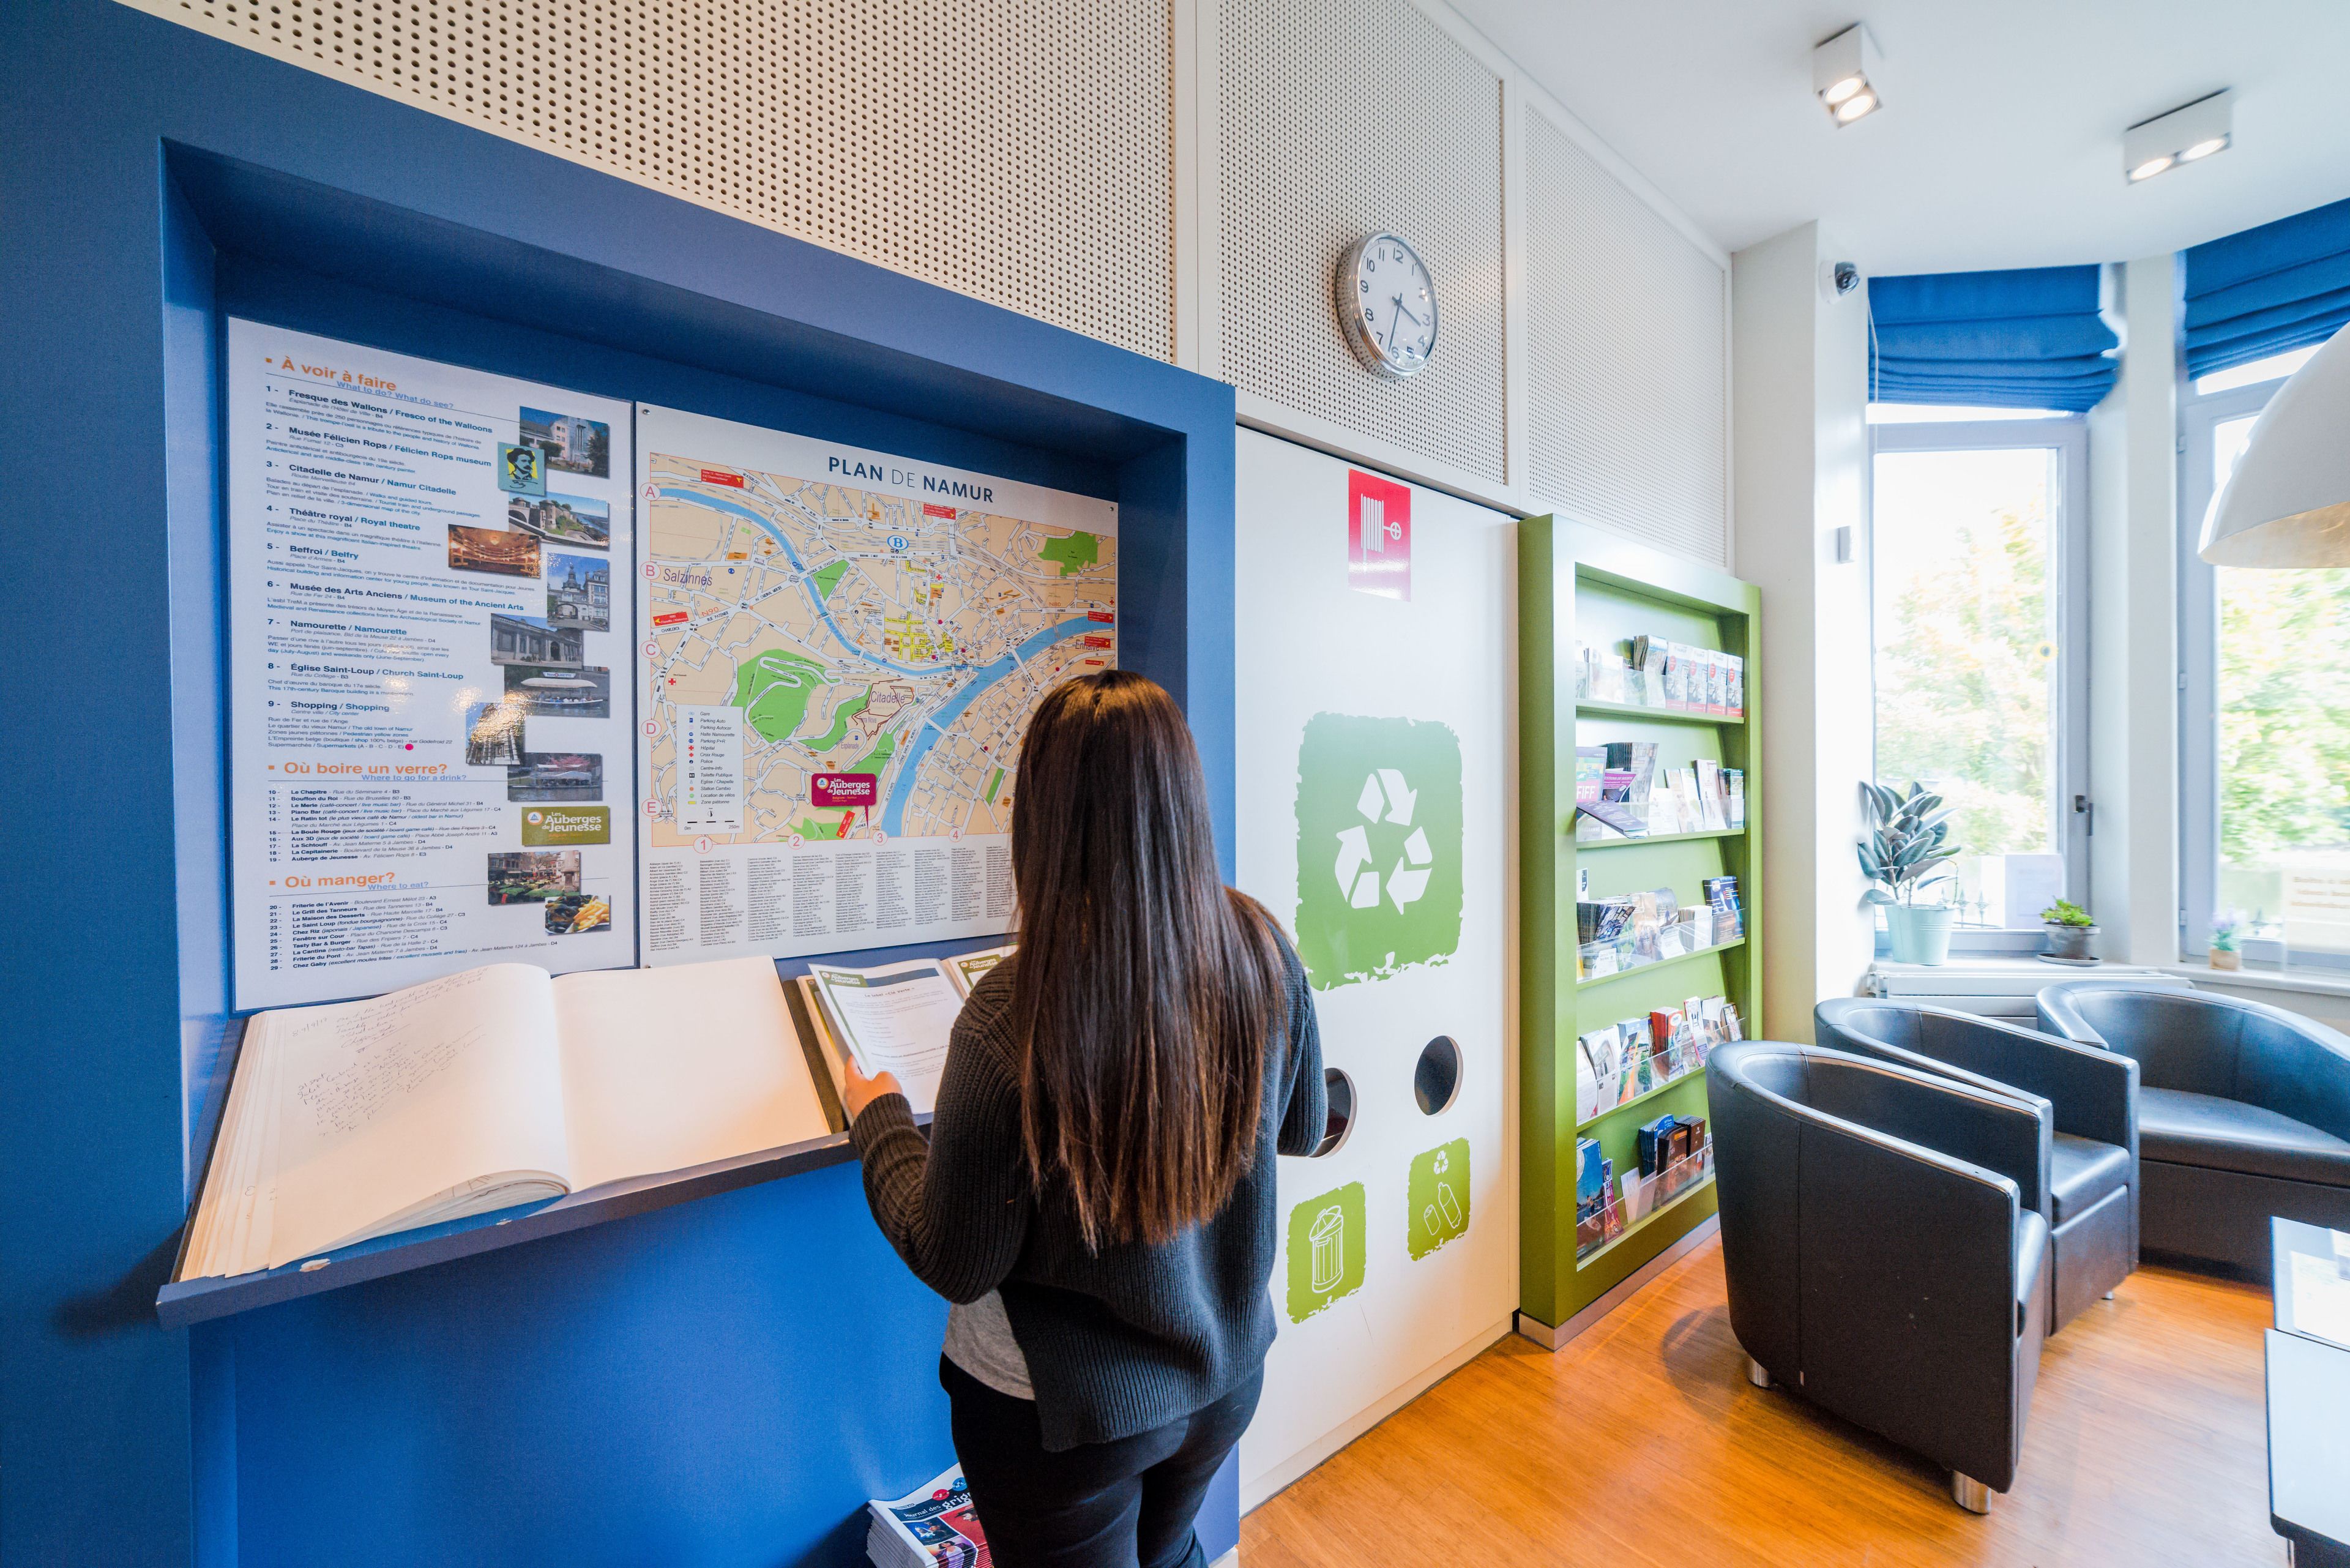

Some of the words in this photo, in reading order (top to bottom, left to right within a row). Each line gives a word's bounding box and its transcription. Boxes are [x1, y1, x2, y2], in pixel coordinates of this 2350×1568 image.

[1379, 247, 1384, 261] 11
[1393, 247, 1403, 264] 12
[1367, 258, 1375, 272] 10
[1360, 280, 1368, 293] 9
[1365, 308, 1373, 321] 8
[1423, 313, 1430, 326] 3
[1376, 331, 1384, 345] 7
[1418, 335, 1425, 347] 4
[1391, 346, 1400, 359] 6
[1407, 346, 1414, 359] 5
[281, 354, 294, 371] À
[300, 362, 337, 379] voir
[341, 369, 352, 383] à
[357, 373, 397, 392] faire
[337, 381, 360, 391] What
[375, 388, 392, 398] do?
[395, 392, 417, 403] What
[420, 397, 431, 405] do
[433, 401, 454, 409] see?
[288, 389, 329, 405] Fresque
[330, 397, 348, 406] des
[350, 400, 388, 414] Wallons
[395, 409, 426, 421] Fresco
[438, 417, 452, 426] the
[454, 420, 493, 433] Walloons
[289, 426, 322, 438] Musée
[323, 432, 360, 444] Félicien
[362, 439, 387, 450] Rops
[394, 444, 429, 456] Félicien
[430, 450, 453, 462] Rops
[455, 456, 491, 466] museum
[289, 463, 334, 477] Citadelle
[348, 472, 379, 483] Namur
[386, 479, 417, 489] Namur
[418, 483, 457, 495] Citadelle
[829, 456, 882, 481] PLAN
[892, 469, 915, 488] DE
[923, 476, 993, 502] NAMUR
[645, 486, 655, 498] A
[288, 507, 327, 519] Théâtre
[329, 512, 352, 524] royal
[360, 517, 387, 528] Royal
[389, 520, 420, 531] theatre
[289, 545, 323, 555] Beffroi
[330, 550, 359, 561] Belfry
[646, 565, 655, 576] B
[663, 569, 712, 586] Salzinnes
[290, 582, 322, 592] Musée
[324, 585, 341, 594] des
[342, 587, 364, 595] Arts
[365, 589, 403, 599] Anciens
[409, 594, 447, 603] Museum
[474, 600, 505, 609] Ancient
[701, 607, 719, 616] N90
[290, 620, 347, 630] Namourette
[354, 625, 408, 635] Namourette
[646, 644, 657, 655] C
[290, 662, 321, 673] Église
[323, 665, 375, 676] Saint-Loup
[381, 668, 415, 677] Church
[417, 670, 464, 681] Saint-Loup
[871, 691, 905, 703] Citadelle
[290, 701, 338, 711] Shopping
[345, 703, 390, 712] Shopping
[646, 723, 657, 734] D
[284, 761, 310, 774] Où
[316, 762, 362, 774] boire
[368, 765, 389, 774] un
[394, 763, 447, 774] verre?
[830, 780, 870, 790] Auberges
[647, 802, 657, 813] E
[545, 813, 602, 826] Auberges
[548, 823, 602, 832] Jeunesse
[952, 829, 959, 838] 4
[700, 838, 706, 851] 1
[793, 835, 800, 847] 2
[877, 833, 883, 843] 3
[284, 875, 311, 888] Où
[318, 871, 395, 889] manger?
